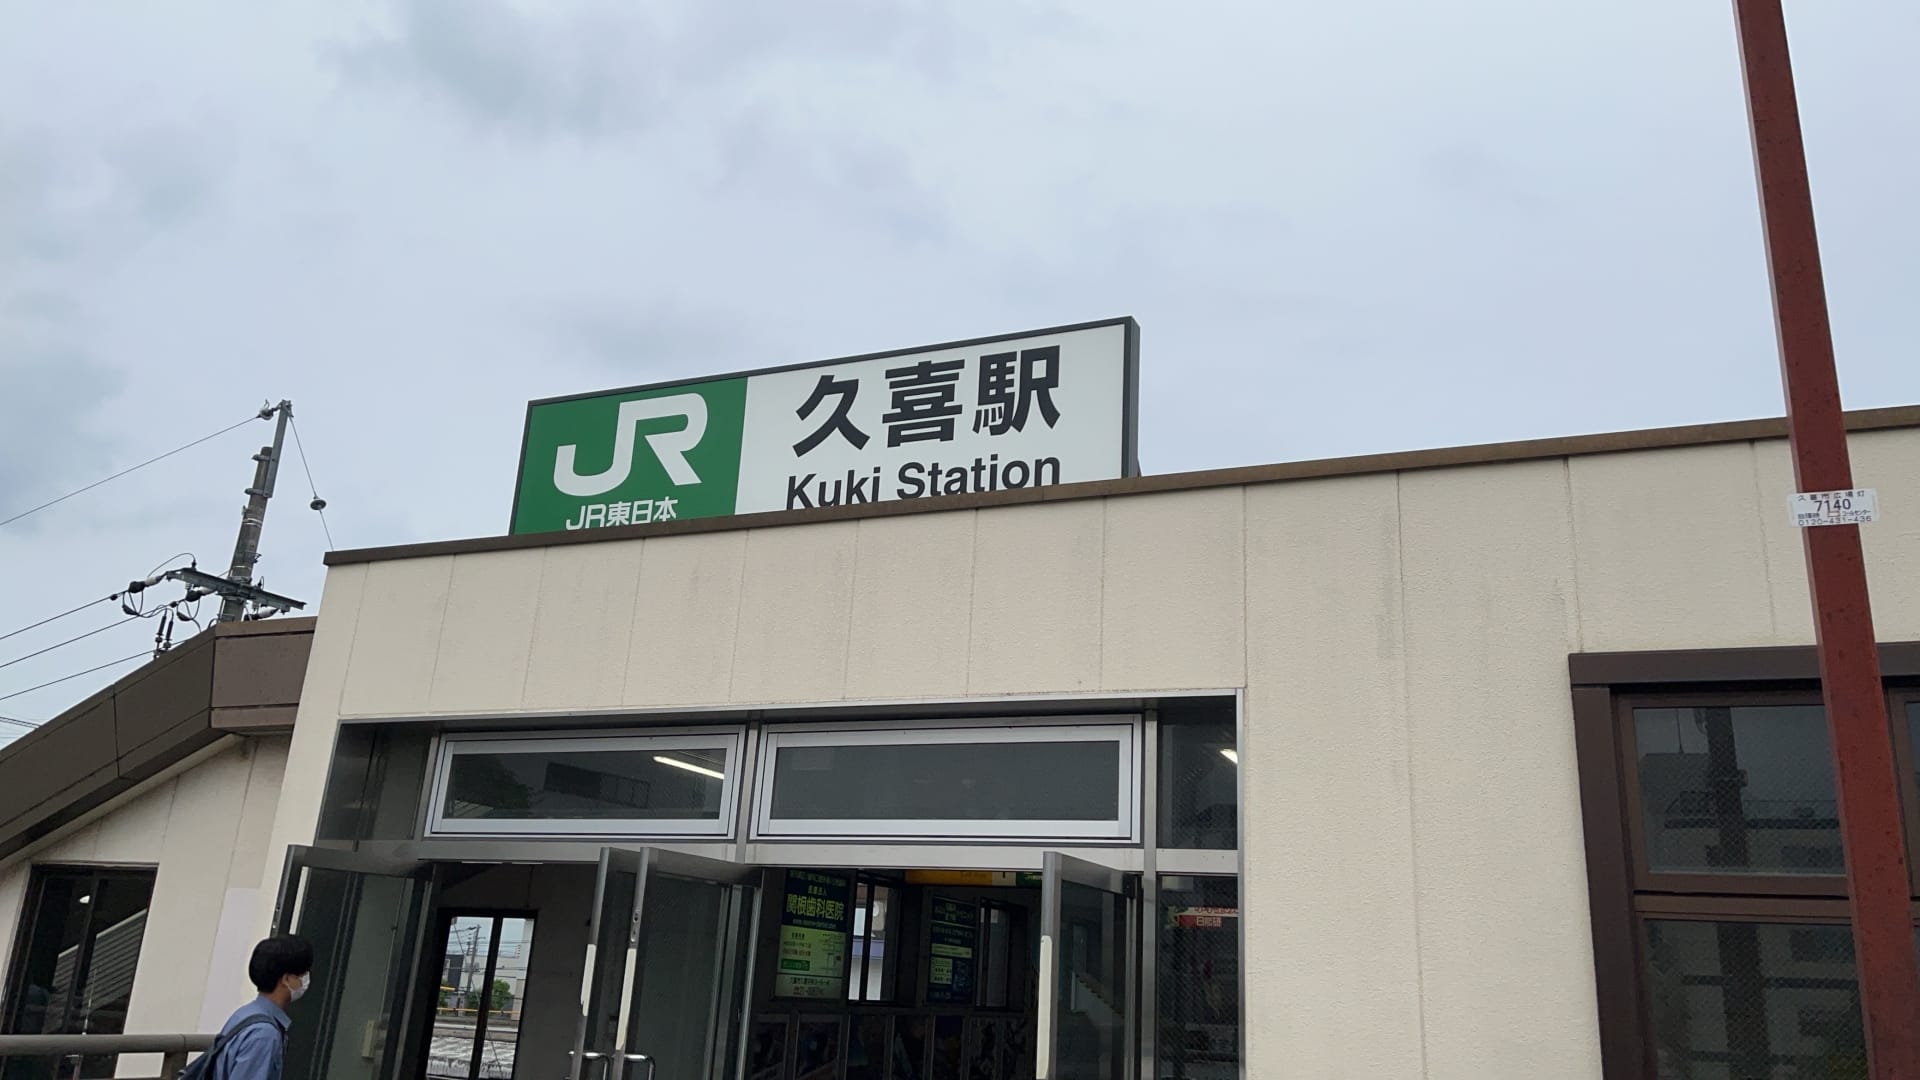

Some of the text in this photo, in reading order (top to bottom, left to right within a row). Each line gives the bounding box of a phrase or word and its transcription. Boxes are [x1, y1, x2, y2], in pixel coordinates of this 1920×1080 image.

[792, 345, 1061, 458] 久喜駅
[553, 392, 708, 497] JR
[786, 453, 1060, 511] Kuki Station
[1814, 498, 1852, 513] 7140
[565, 496, 679, 531] JR東日本
